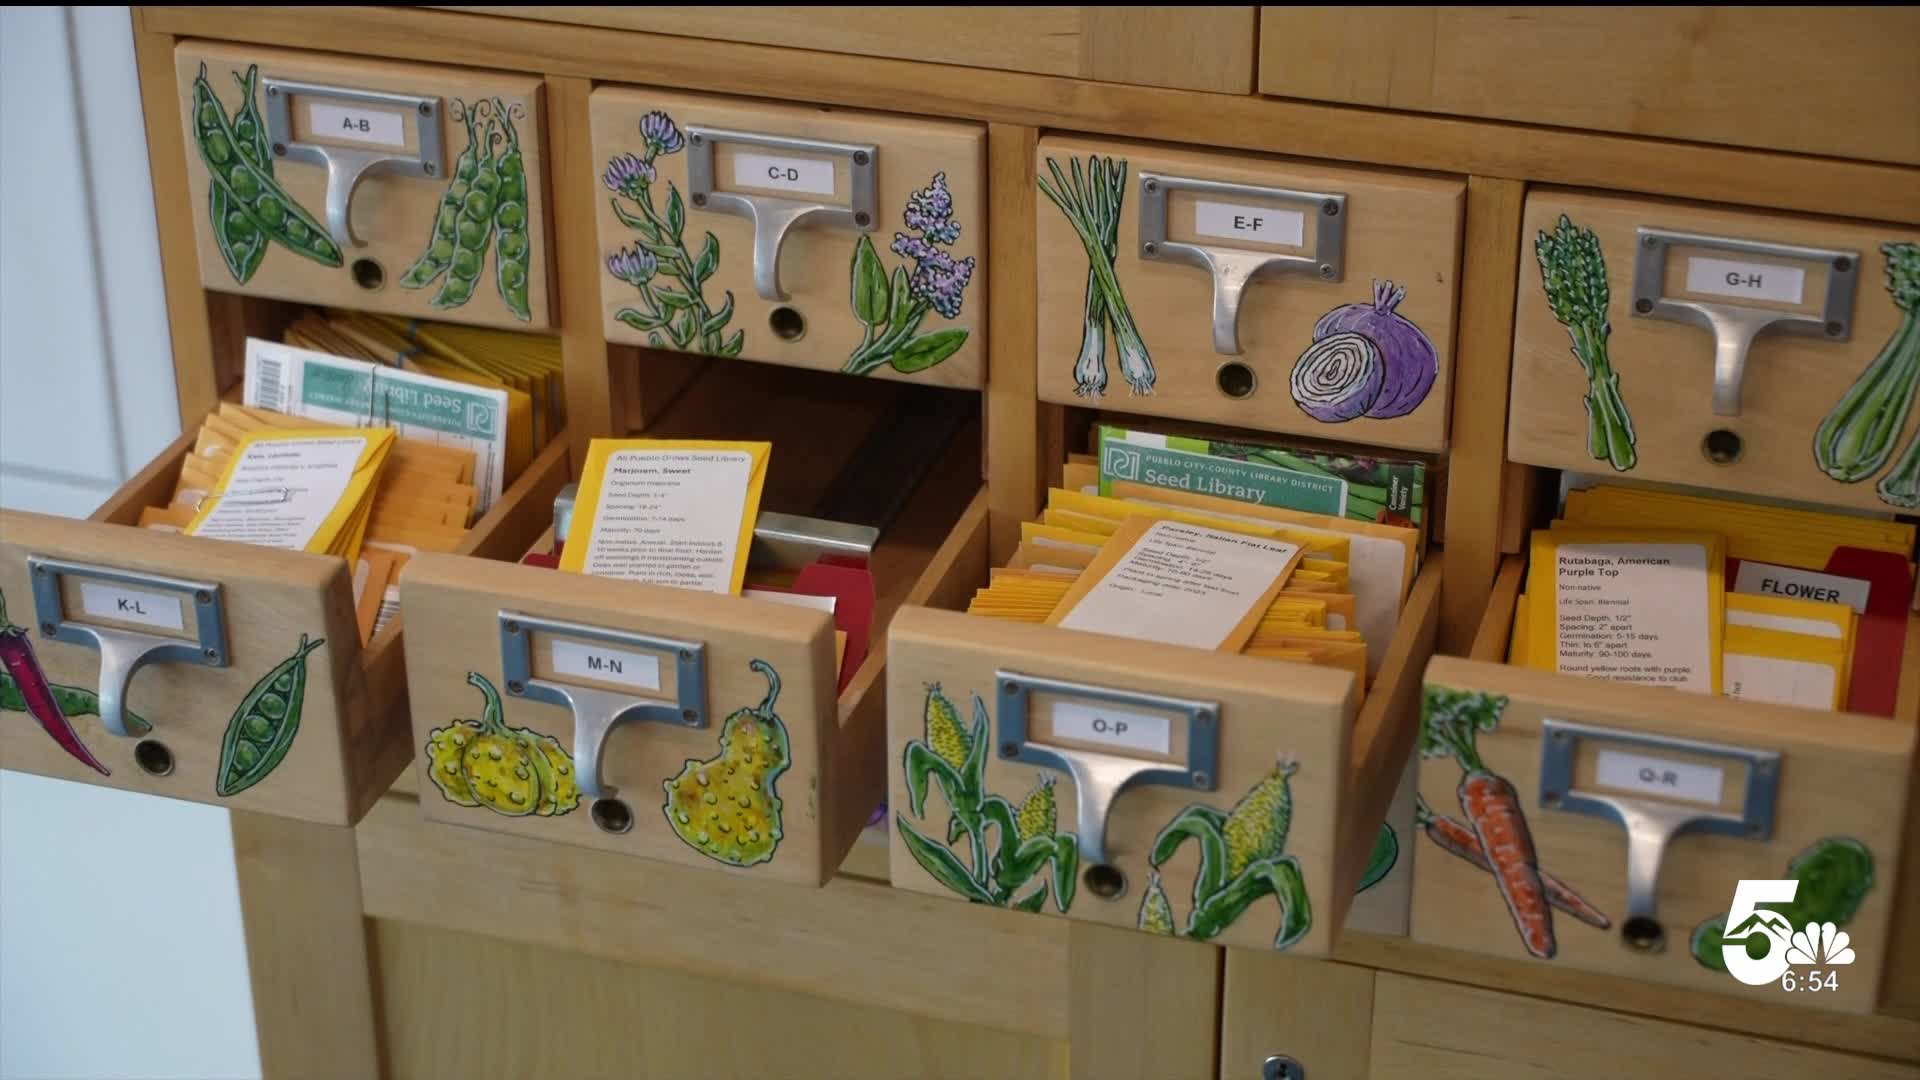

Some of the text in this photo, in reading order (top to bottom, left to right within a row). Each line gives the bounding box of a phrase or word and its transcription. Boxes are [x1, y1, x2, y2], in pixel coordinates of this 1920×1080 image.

[342, 117, 371, 132] A-B
[768, 166, 799, 181] C-D
[1233, 215, 1264, 231] E-F
[1725, 271, 1763, 288] G-H
[423, 392, 462, 413] Seed
[1145, 455, 1334, 494] PUEBLO CITY-COUNTY LIBRARY DISTRICT
[1144, 468, 1267, 505] Seed Library
[1559, 557, 1671, 567] Rutabaga, American
[1559, 567, 1619, 577] Purple Top
[1559, 583, 1602, 592] Non-native
[1760, 578, 1841, 604] FLOWER
[116, 598, 147, 615] K-L
[1559, 598, 1573, 606] Life
[1560, 614, 1582, 622] Seed
[1559, 623, 1597, 632] Spacing:
[1610, 624, 1633, 632] apart
[1559, 632, 1613, 640] Germination:
[1605, 642, 1628, 650] apart
[587, 655, 623, 674] M-N
[1559, 664, 1589, 673] Round
[1590, 665, 1618, 674] yellow
[1643, 665, 1662, 673] with
[1091, 719, 1129, 736] O-P
[1638, 767, 1679, 786] Q-R
